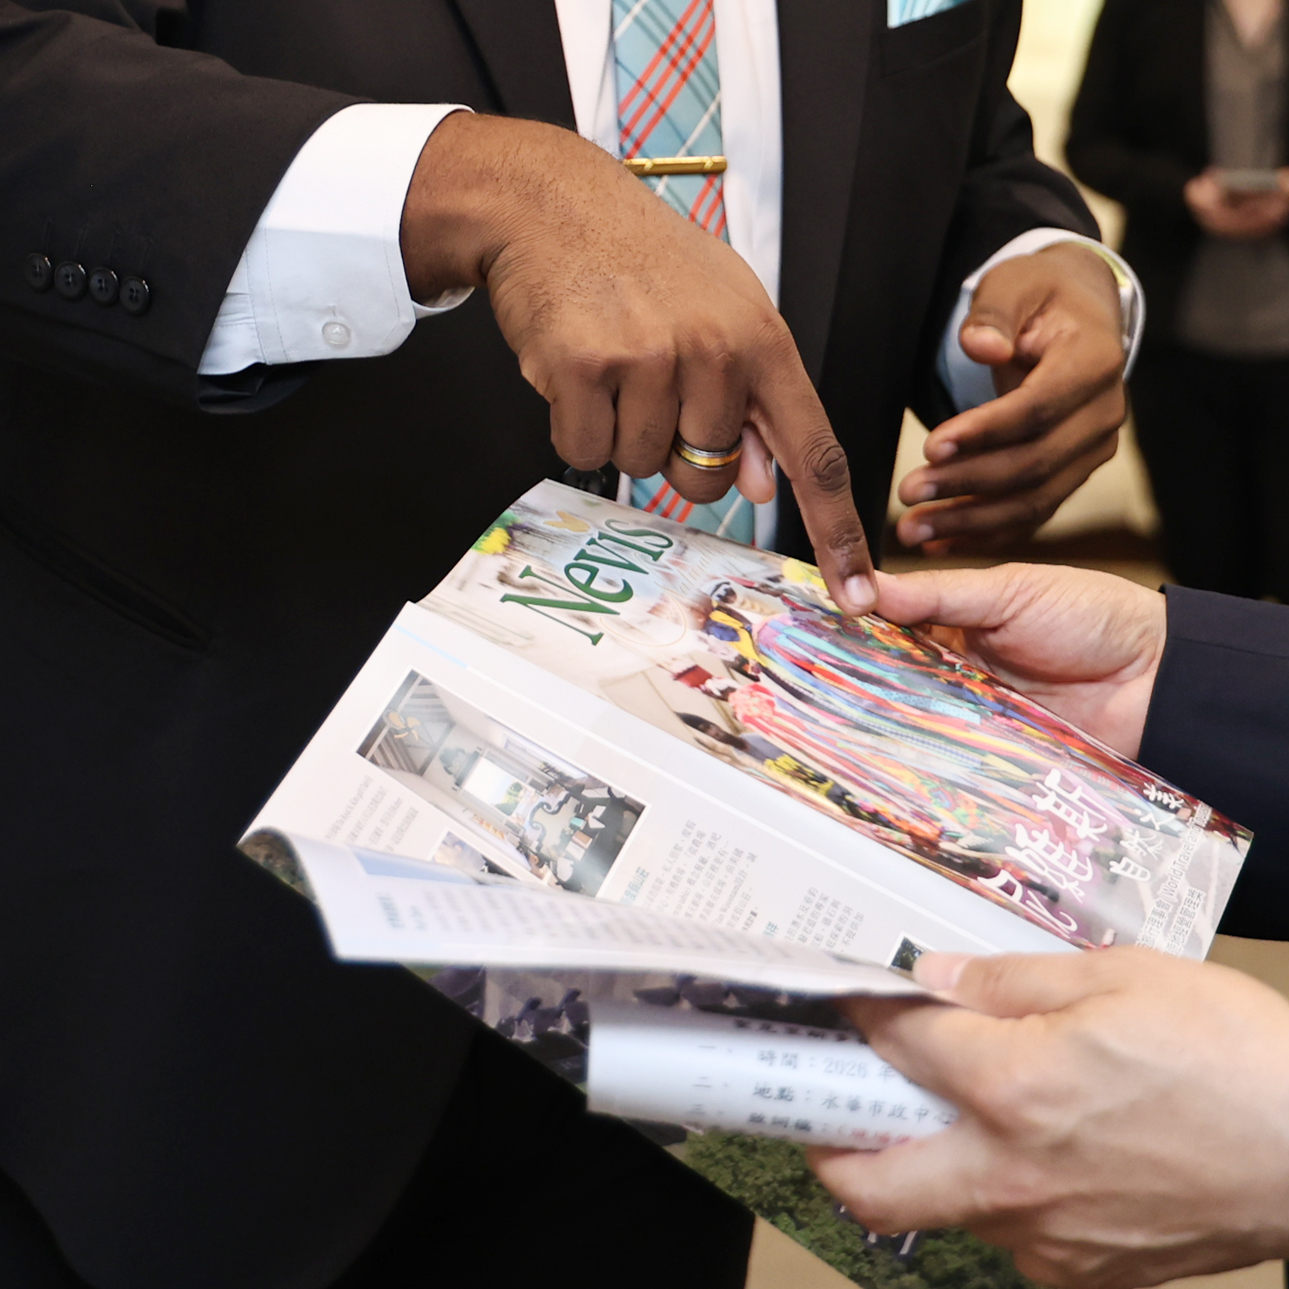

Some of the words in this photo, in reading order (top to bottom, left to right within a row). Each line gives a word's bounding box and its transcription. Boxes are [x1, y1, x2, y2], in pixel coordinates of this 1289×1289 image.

[500, 518, 674, 646] Nevis
[977, 768, 1123, 939] 尼維斯
[1109, 781, 1185, 882] 自然之美
[1171, 839, 1195, 870] Travel
